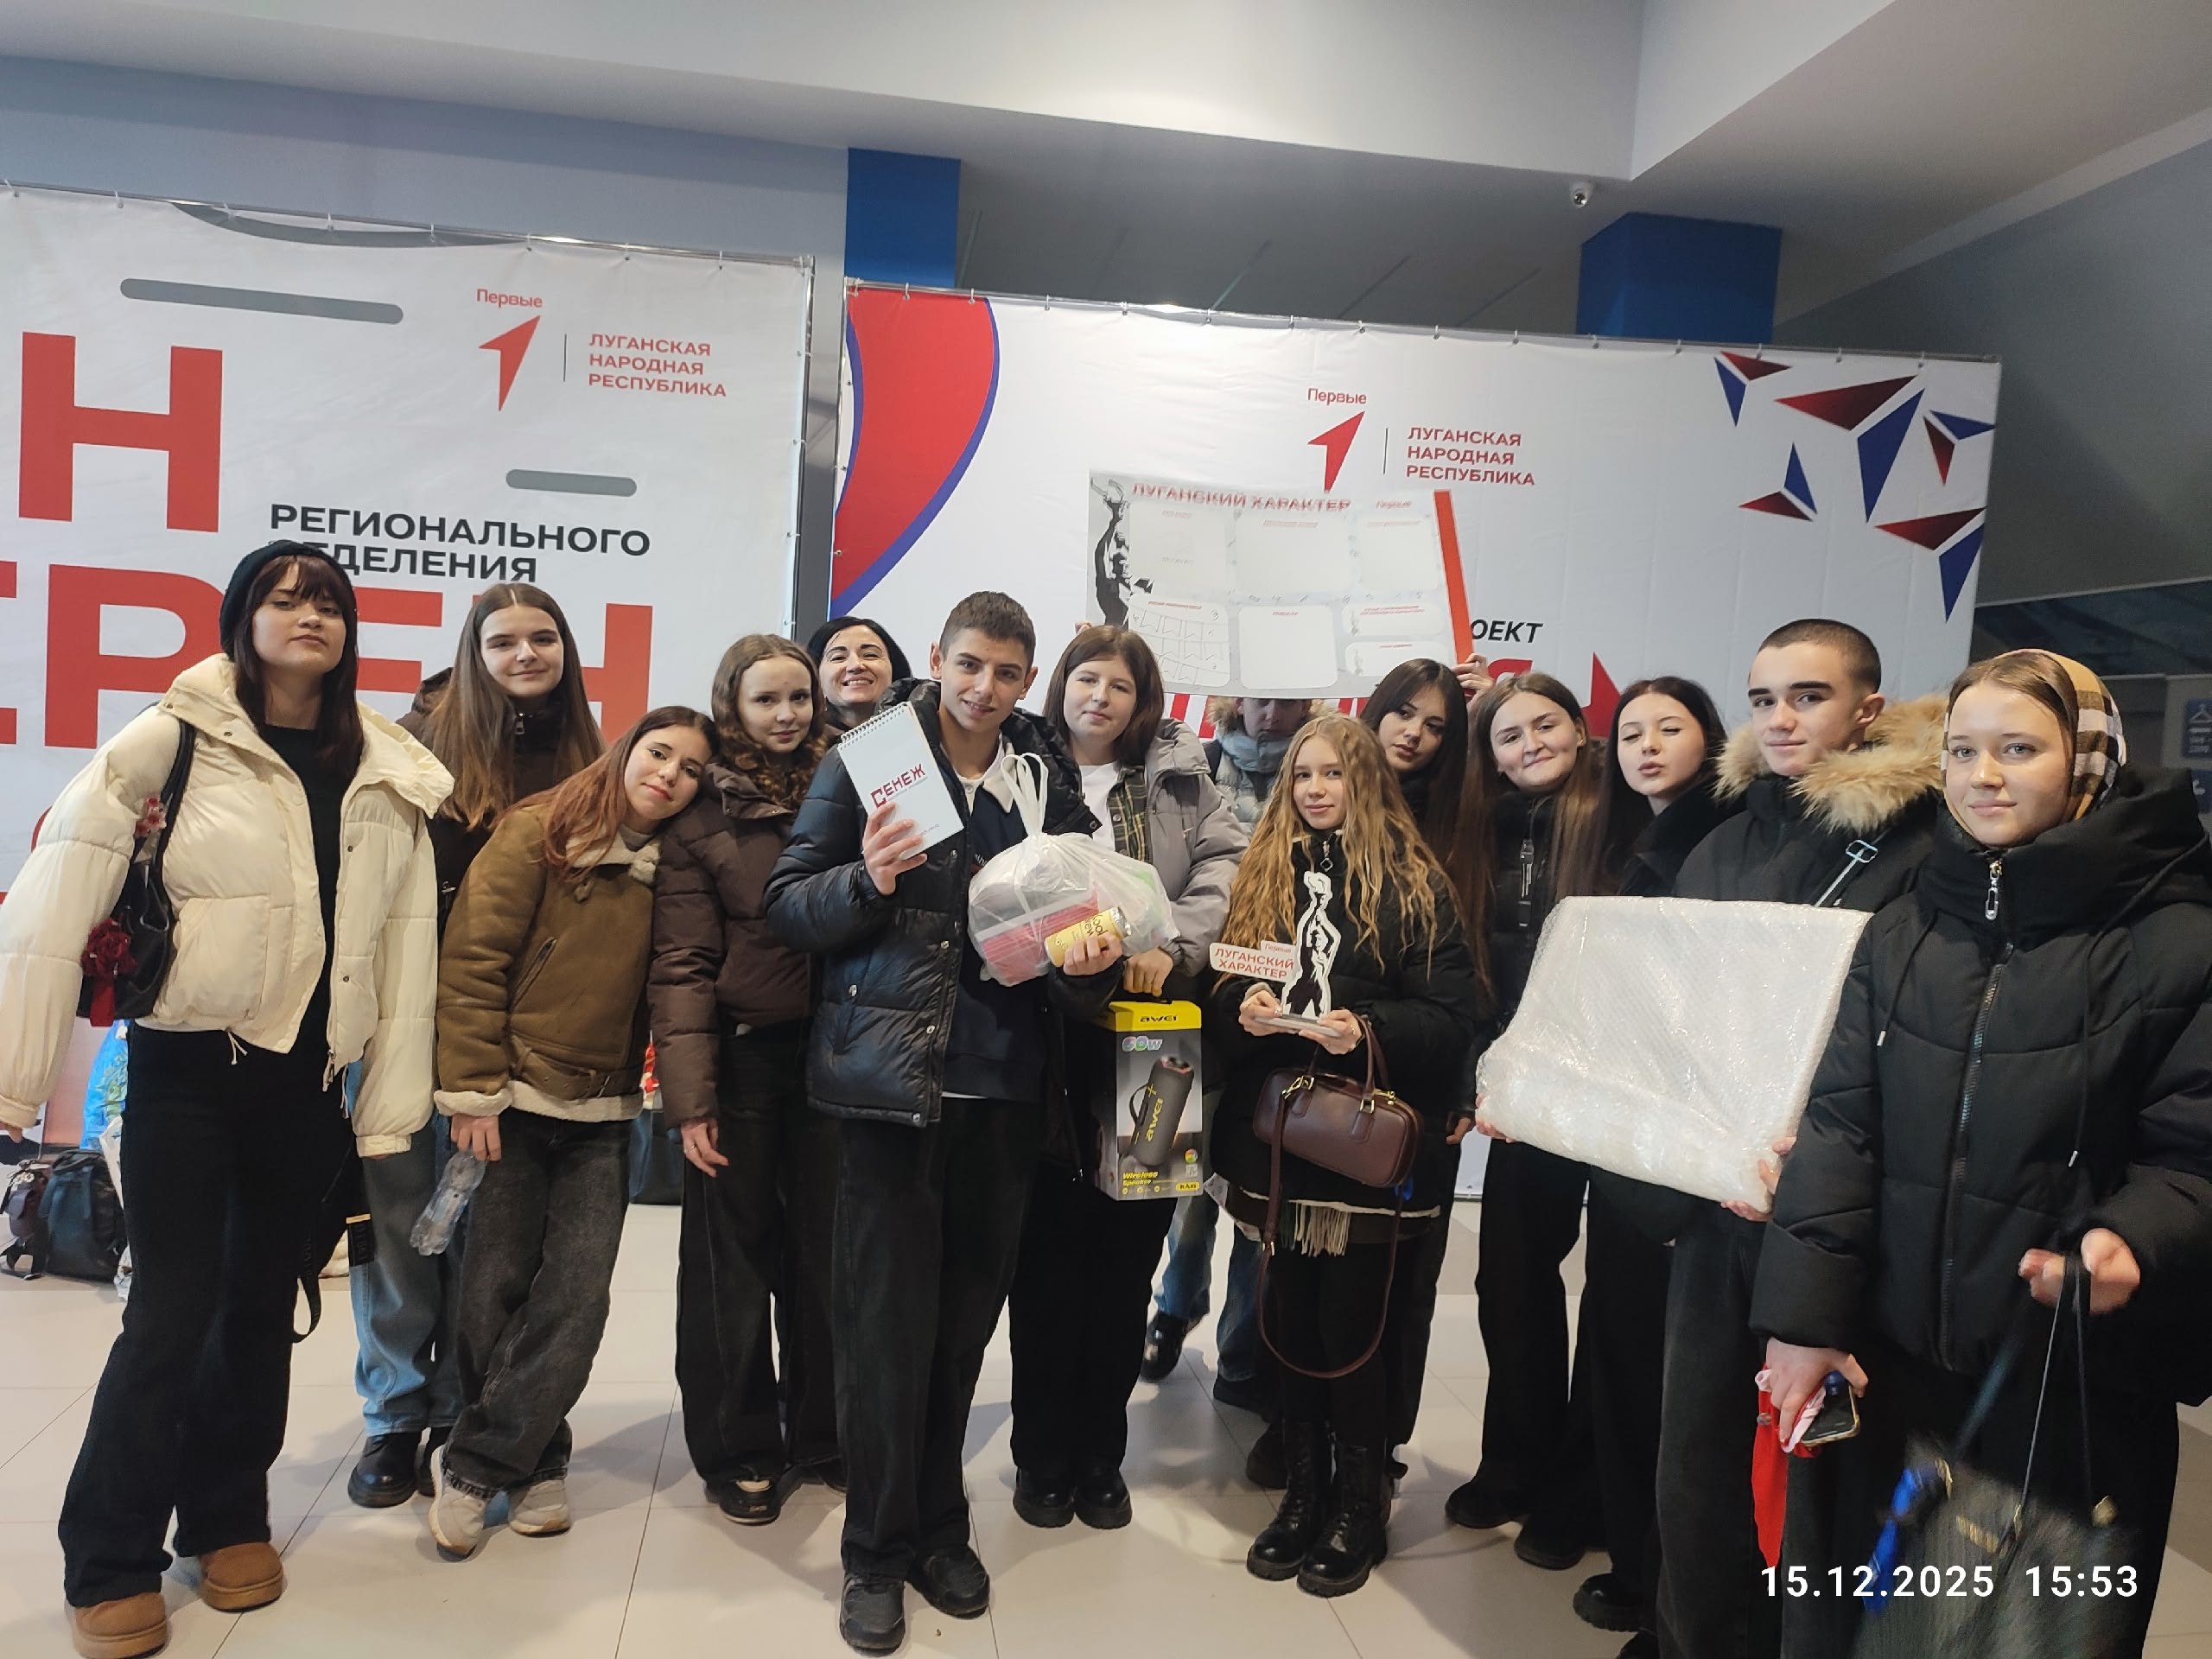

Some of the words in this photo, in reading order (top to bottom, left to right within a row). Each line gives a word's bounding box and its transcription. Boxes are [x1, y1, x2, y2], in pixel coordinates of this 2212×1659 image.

[477, 289, 543, 308] Первые
[589, 334, 711, 356] ЛУГАНСКАЯ
[589, 353, 704, 375] НАРОДНАЯ
[588, 373, 727, 397] РЕСПУБЛИКА
[1307, 388, 1367, 405] Первые
[1408, 427, 1522, 447] ЛУГАНСКАЯ
[1408, 446, 1515, 465] НАРОДНАЯ
[1407, 465, 1535, 486] РЕСПУБЛИКА
[270, 504, 651, 556] РЕГИОНАЛЬНОГО
[269, 541, 537, 582] ДЕЛЕНИЯ
[1215, 948, 1294, 969] ЛУГАНСКИЙ
[1218, 959, 1287, 979] ХАРАКТЕР
